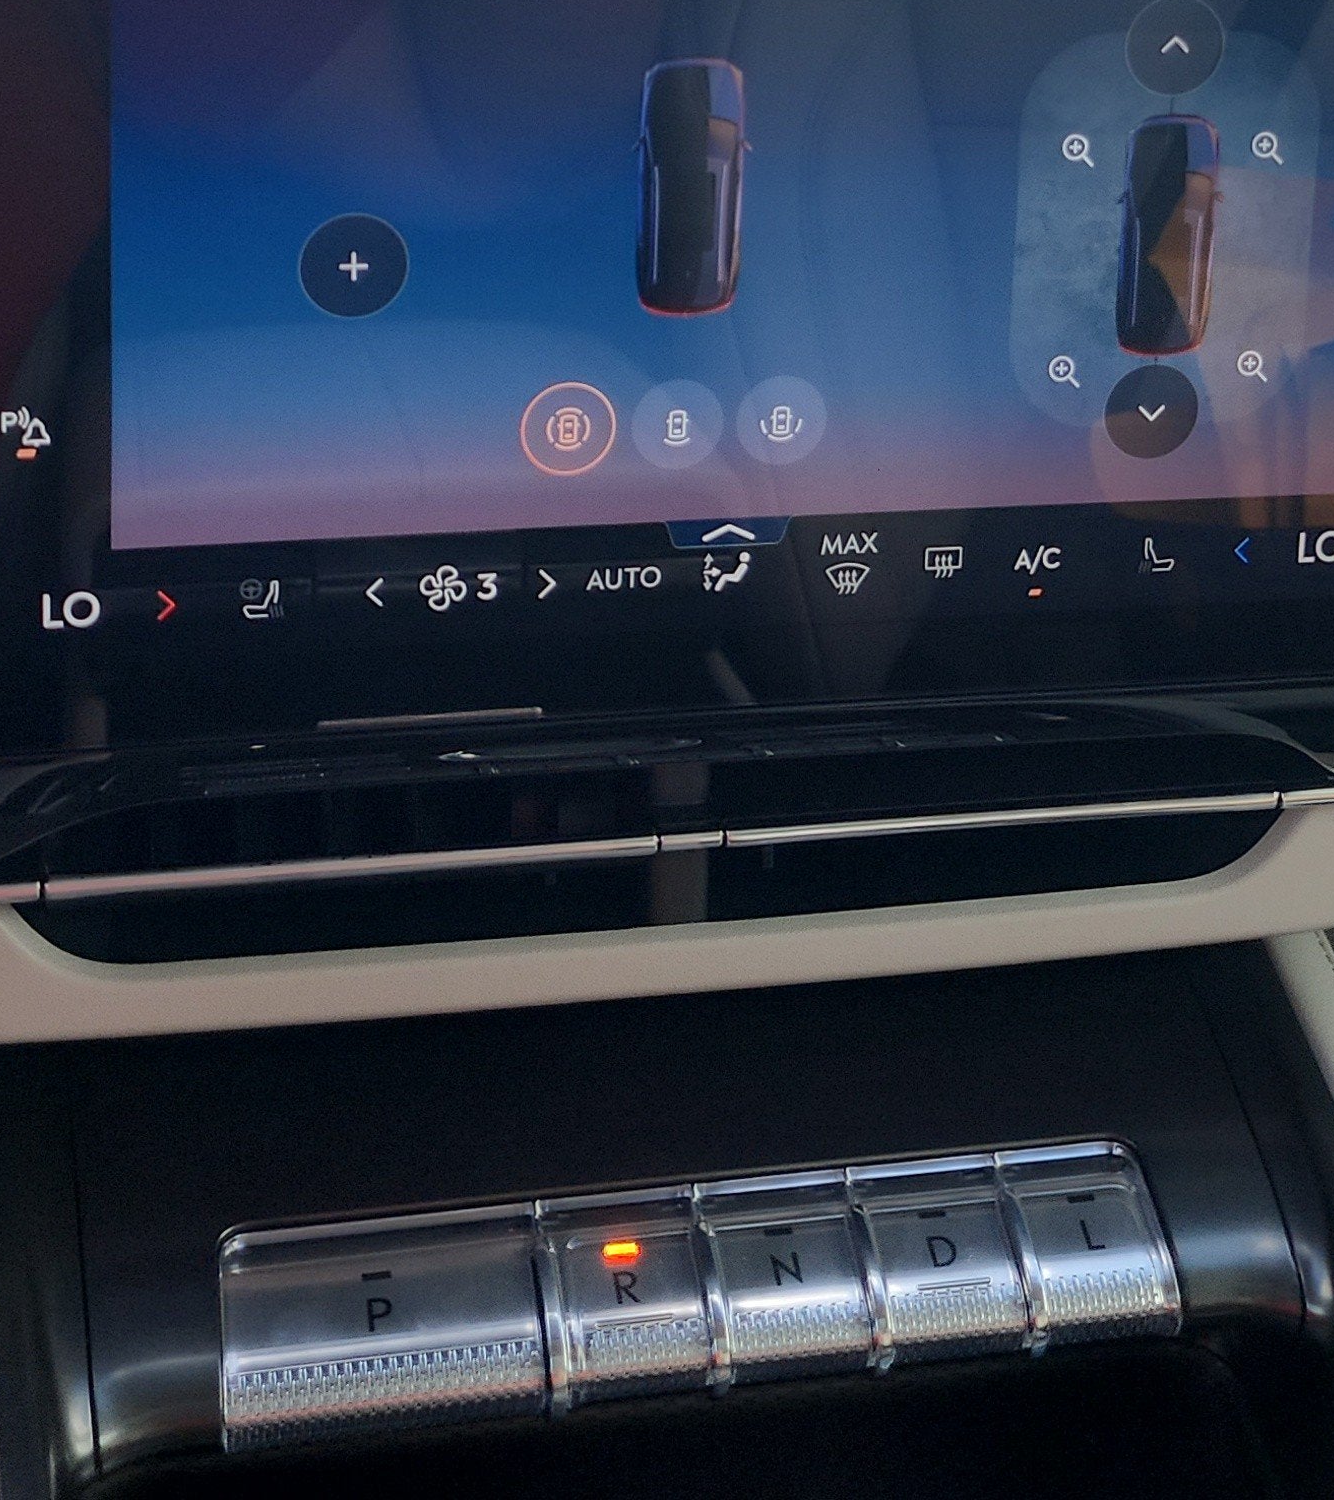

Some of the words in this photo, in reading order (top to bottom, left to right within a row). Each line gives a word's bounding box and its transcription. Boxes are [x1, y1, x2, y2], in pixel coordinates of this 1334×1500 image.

[819, 531, 880, 556] MAX
[1013, 544, 1063, 575] A/C
[476, 571, 499, 601] 3
[585, 564, 663, 592] AUTO
[41, 591, 102, 630] LO
[925, 1234, 958, 1269] D
[1079, 1217, 1106, 1252] L
[768, 1250, 803, 1288] N
[611, 1270, 642, 1306] R
[365, 1296, 394, 1333] P
